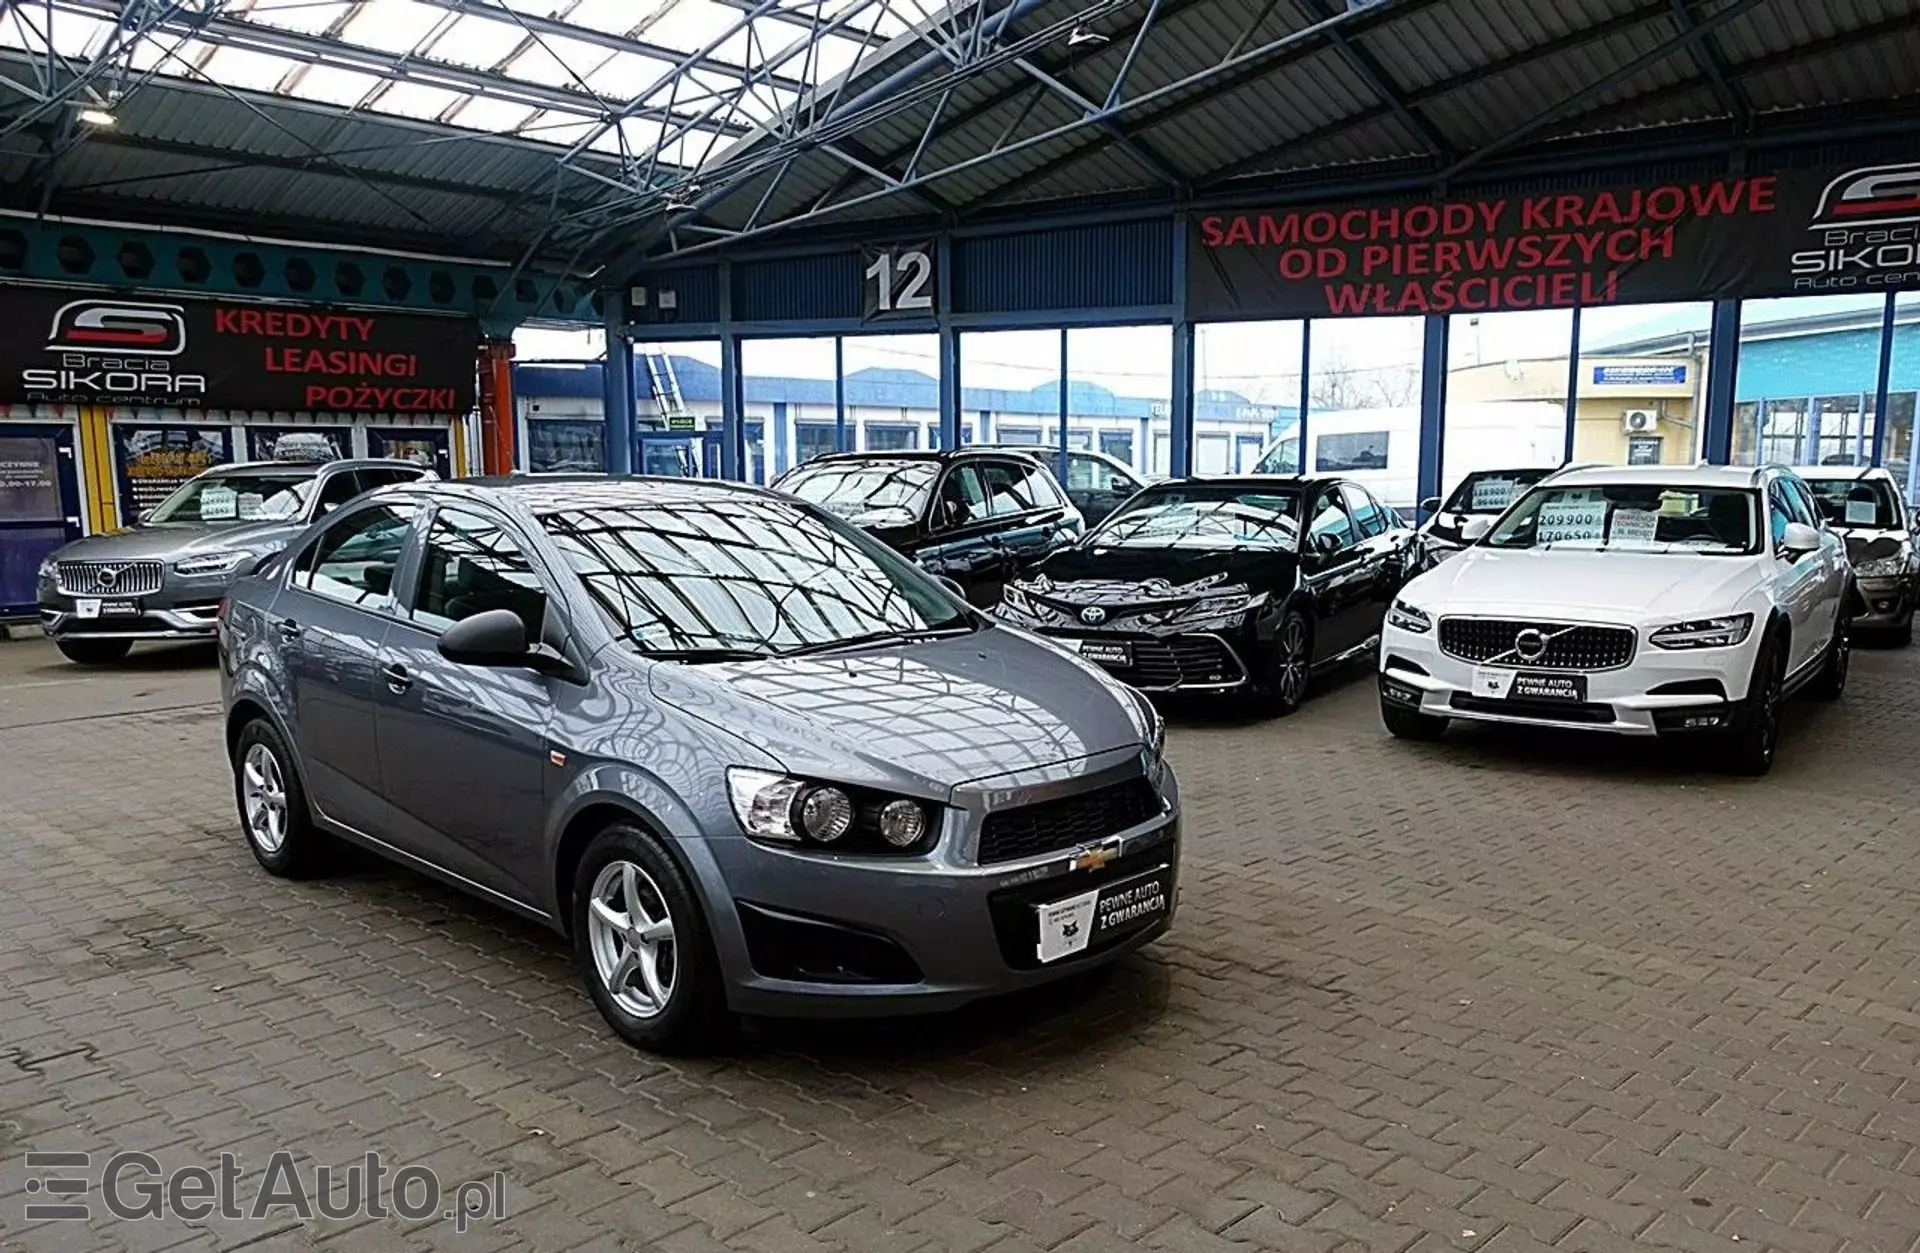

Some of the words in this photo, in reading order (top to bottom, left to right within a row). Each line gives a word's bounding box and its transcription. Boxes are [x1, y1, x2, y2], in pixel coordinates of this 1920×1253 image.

[1202, 199, 1506, 246] SAMOCHODY
[1522, 176, 1777, 230] KRAJOWE
[1279, 247, 1348, 280] OD
[1362, 225, 1675, 276] PIERWSZYCH
[1791, 243, 1920, 274] SIKO
[865, 251, 933, 311] 12
[1324, 270, 1618, 314] WŁAŚCICIELI
[1794, 275, 1857, 289] Auto
[214, 308, 375, 342] KREDYTY
[63, 353, 170, 371] Bracia
[265, 347, 417, 376] LEASINGI
[22, 369, 206, 393] SIKORA
[305, 382, 456, 410] POŻYCZKI
[1540, 514, 1593, 526] 209900
[1537, 530, 1591, 542] 170650
[1517, 685, 1523, 694] Z
[1547, 679, 1573, 688] AUTO
[1100, 889, 1133, 914] PEWNE
[1134, 880, 1159, 901] AUTO
[1101, 914, 1107, 930] Z
